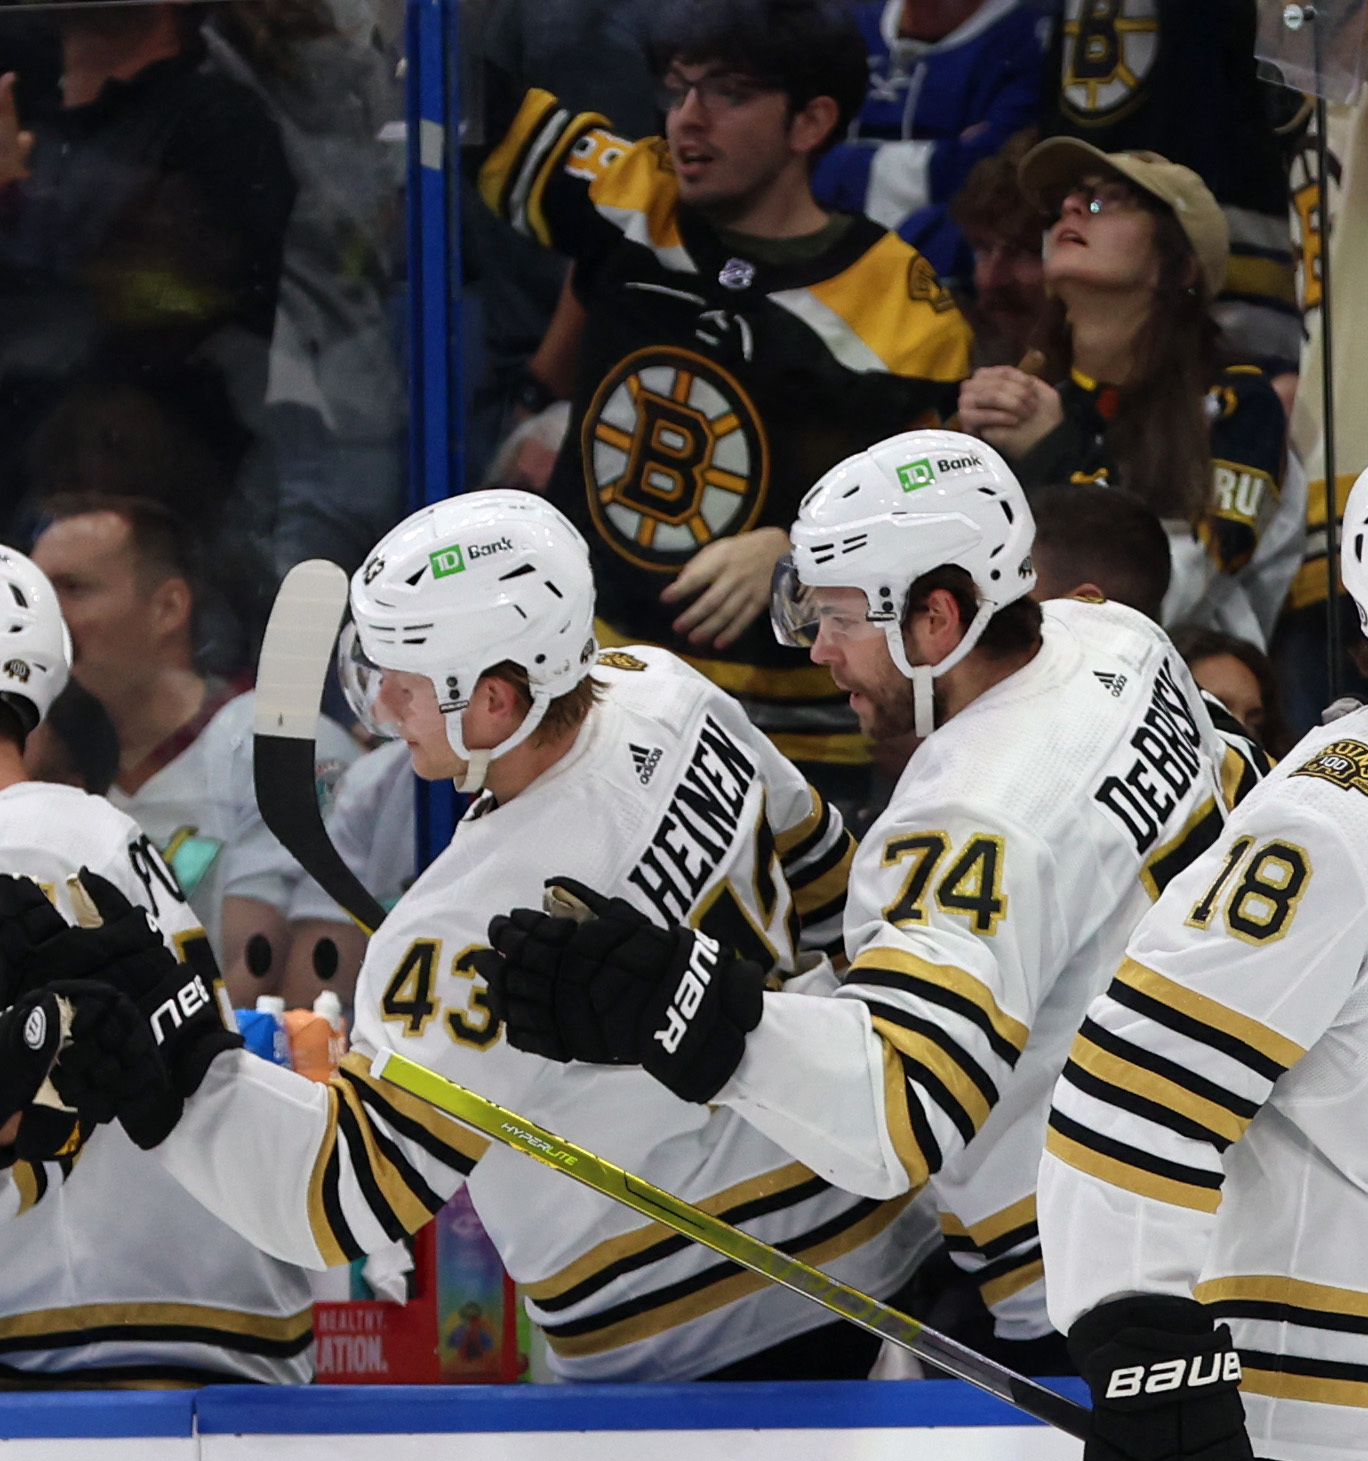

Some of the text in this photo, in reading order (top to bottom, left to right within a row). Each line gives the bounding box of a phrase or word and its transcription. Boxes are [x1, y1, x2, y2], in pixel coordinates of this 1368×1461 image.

[898, 454, 982, 489] TD Bank
[430, 537, 514, 575] TD Bank
[639, 747, 663, 785] adidas
[1318, 754, 1349, 772] 100
[626, 713, 756, 928] HEINEN
[878, 830, 1008, 937] 74
[1184, 836, 1315, 947] 18
[380, 938, 505, 1052] 43
[500, 1121, 579, 1167] HYPERLITE
